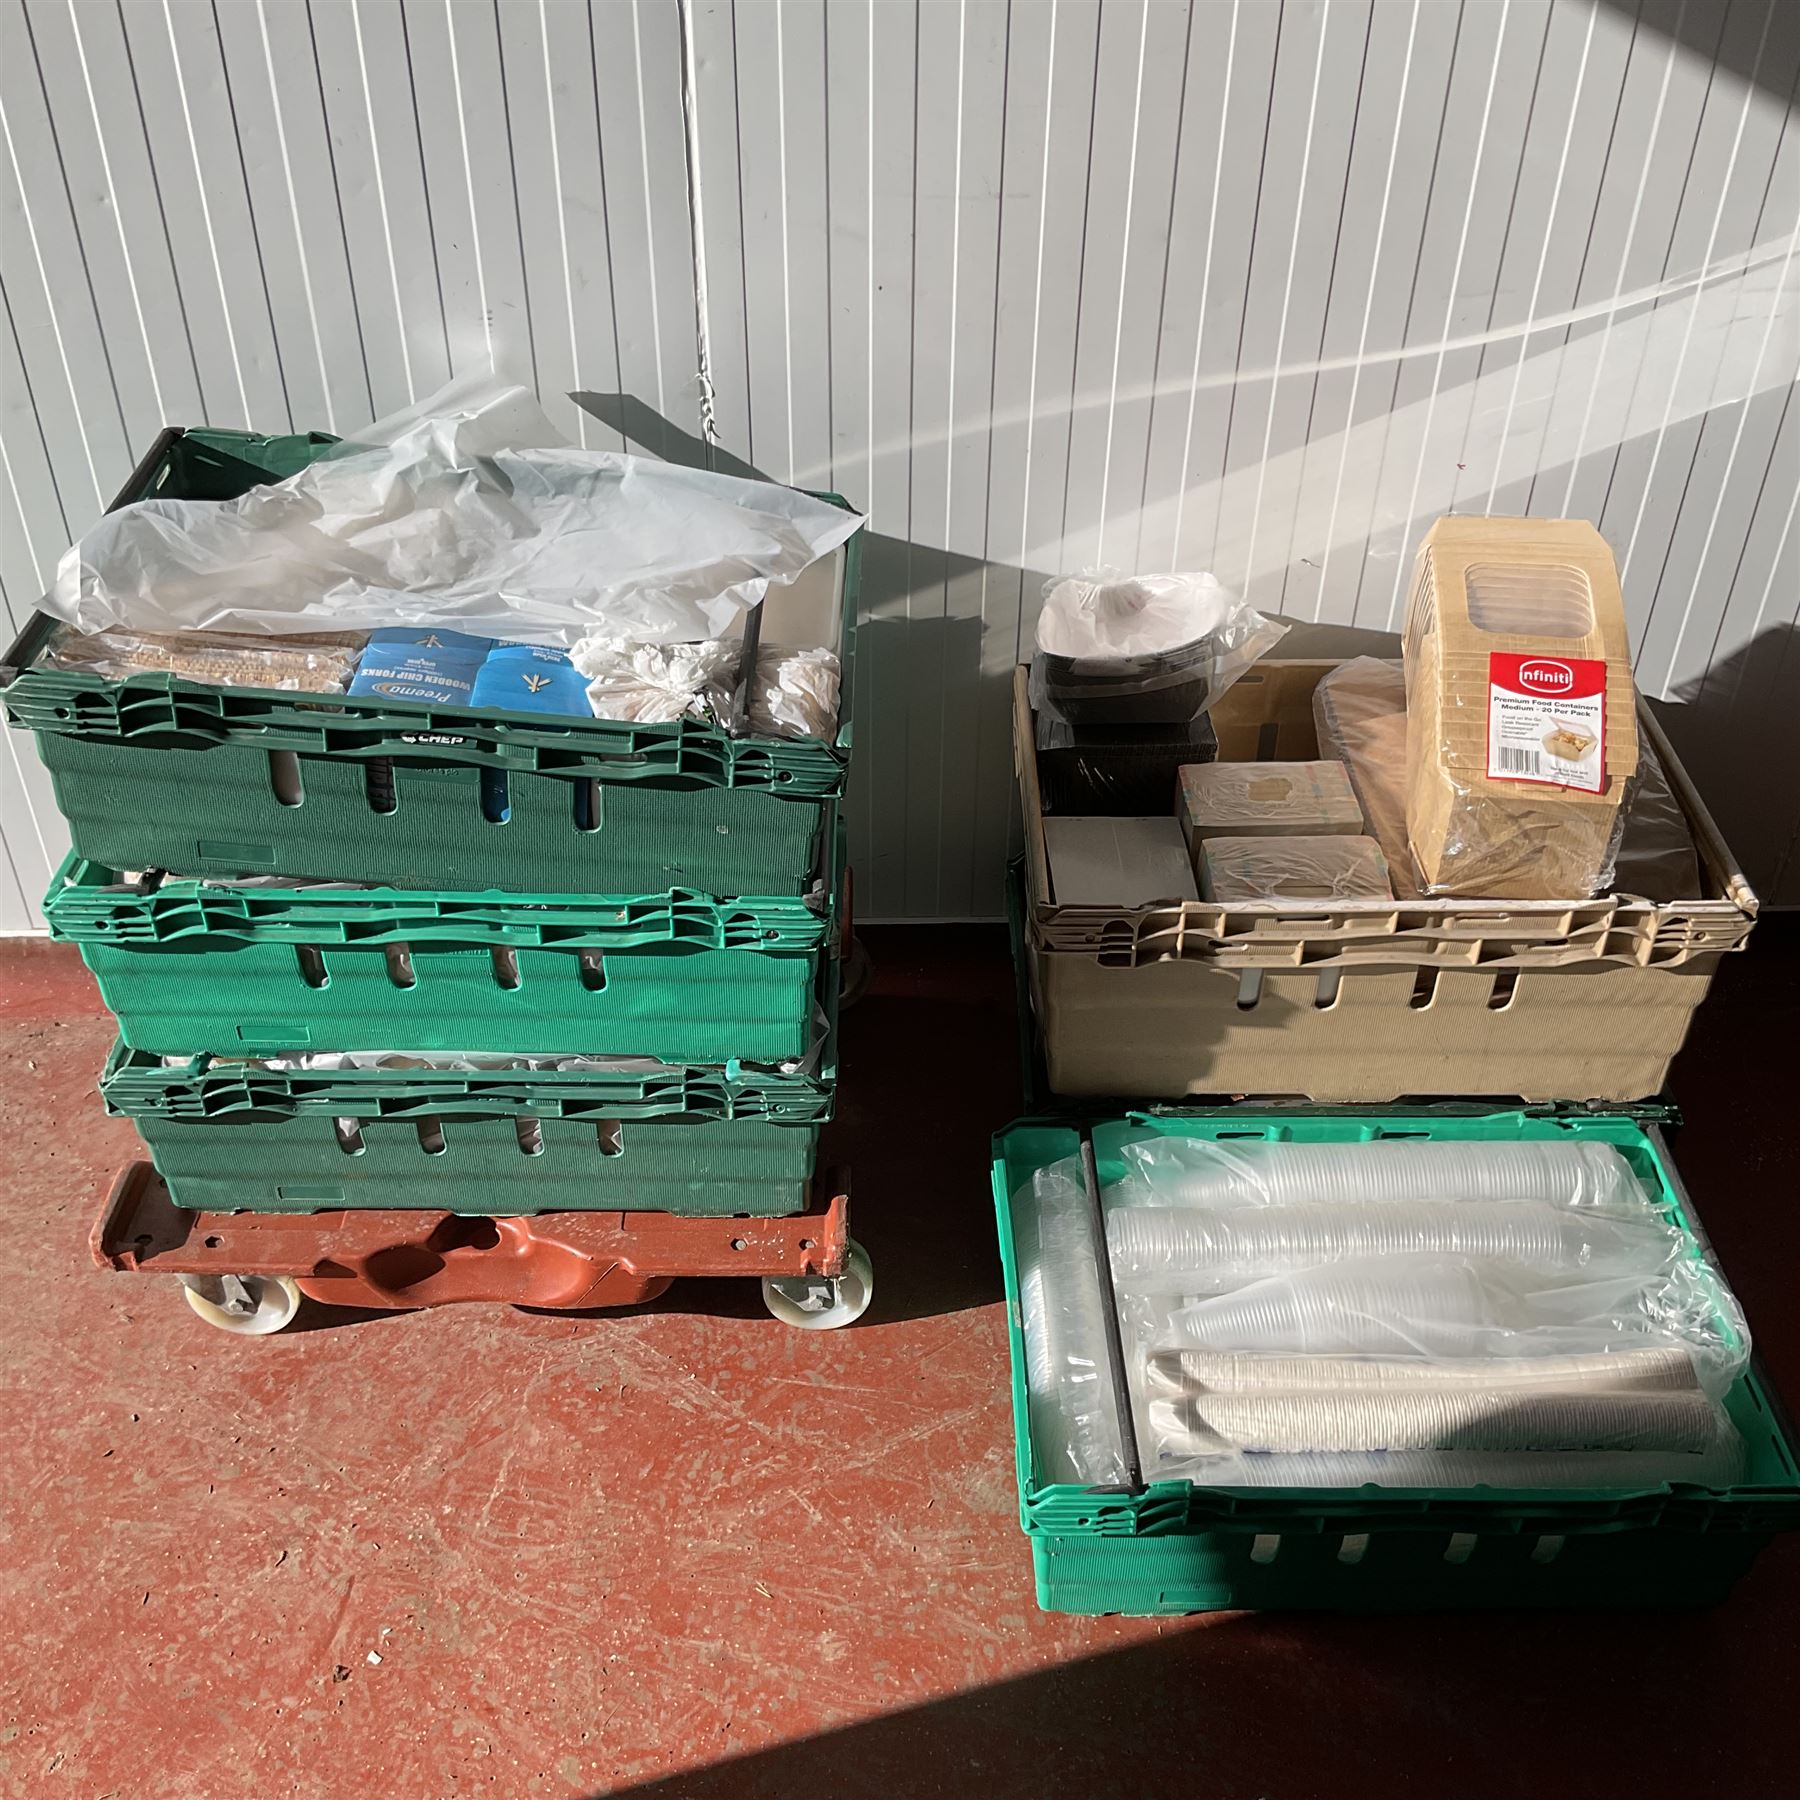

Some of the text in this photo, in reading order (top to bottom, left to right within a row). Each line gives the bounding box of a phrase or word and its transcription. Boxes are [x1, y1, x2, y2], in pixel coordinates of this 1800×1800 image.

[361, 668, 396, 679] FORKS
[396, 671, 423, 682] CHIP
[425, 675, 470, 691] WOODEN
[389, 685, 452, 703] Preema
[1494, 696, 1530, 704] Premium
[1554, 701, 1598, 711] Containers
[1570, 709, 1591, 717] Pack
[418, 733, 463, 745] CHEP
